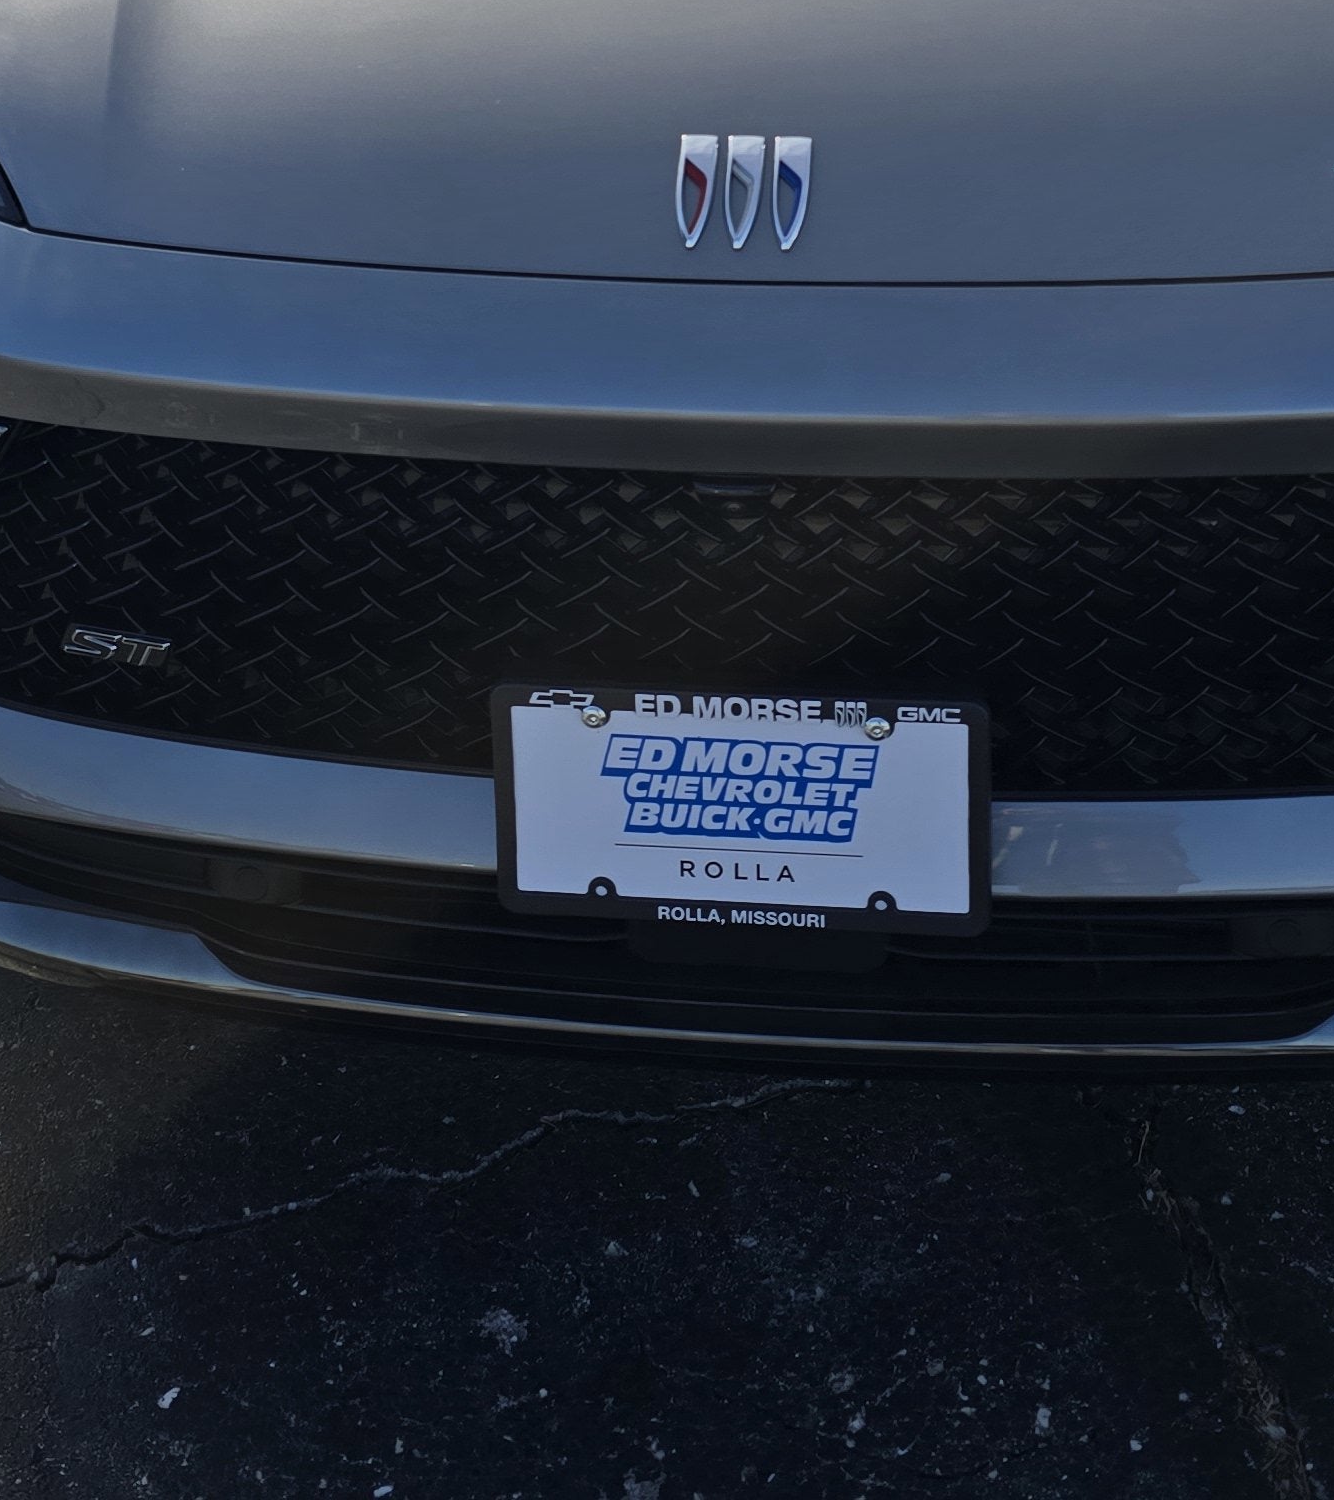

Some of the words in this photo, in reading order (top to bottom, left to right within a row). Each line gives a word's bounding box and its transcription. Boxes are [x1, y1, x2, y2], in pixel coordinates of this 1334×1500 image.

[64, 627, 171, 667] ST
[634, 693, 681, 718] ED
[693, 697, 821, 722] MORSE
[896, 706, 962, 724] GMC
[605, 738, 676, 770] ED
[681, 741, 876, 779] MORSE
[626, 773, 855, 807] CHEVROLET
[679, 860, 795, 884] ROLLA
[657, 905, 726, 924] ROLLA,
[731, 909, 825, 929] MISSOURI
